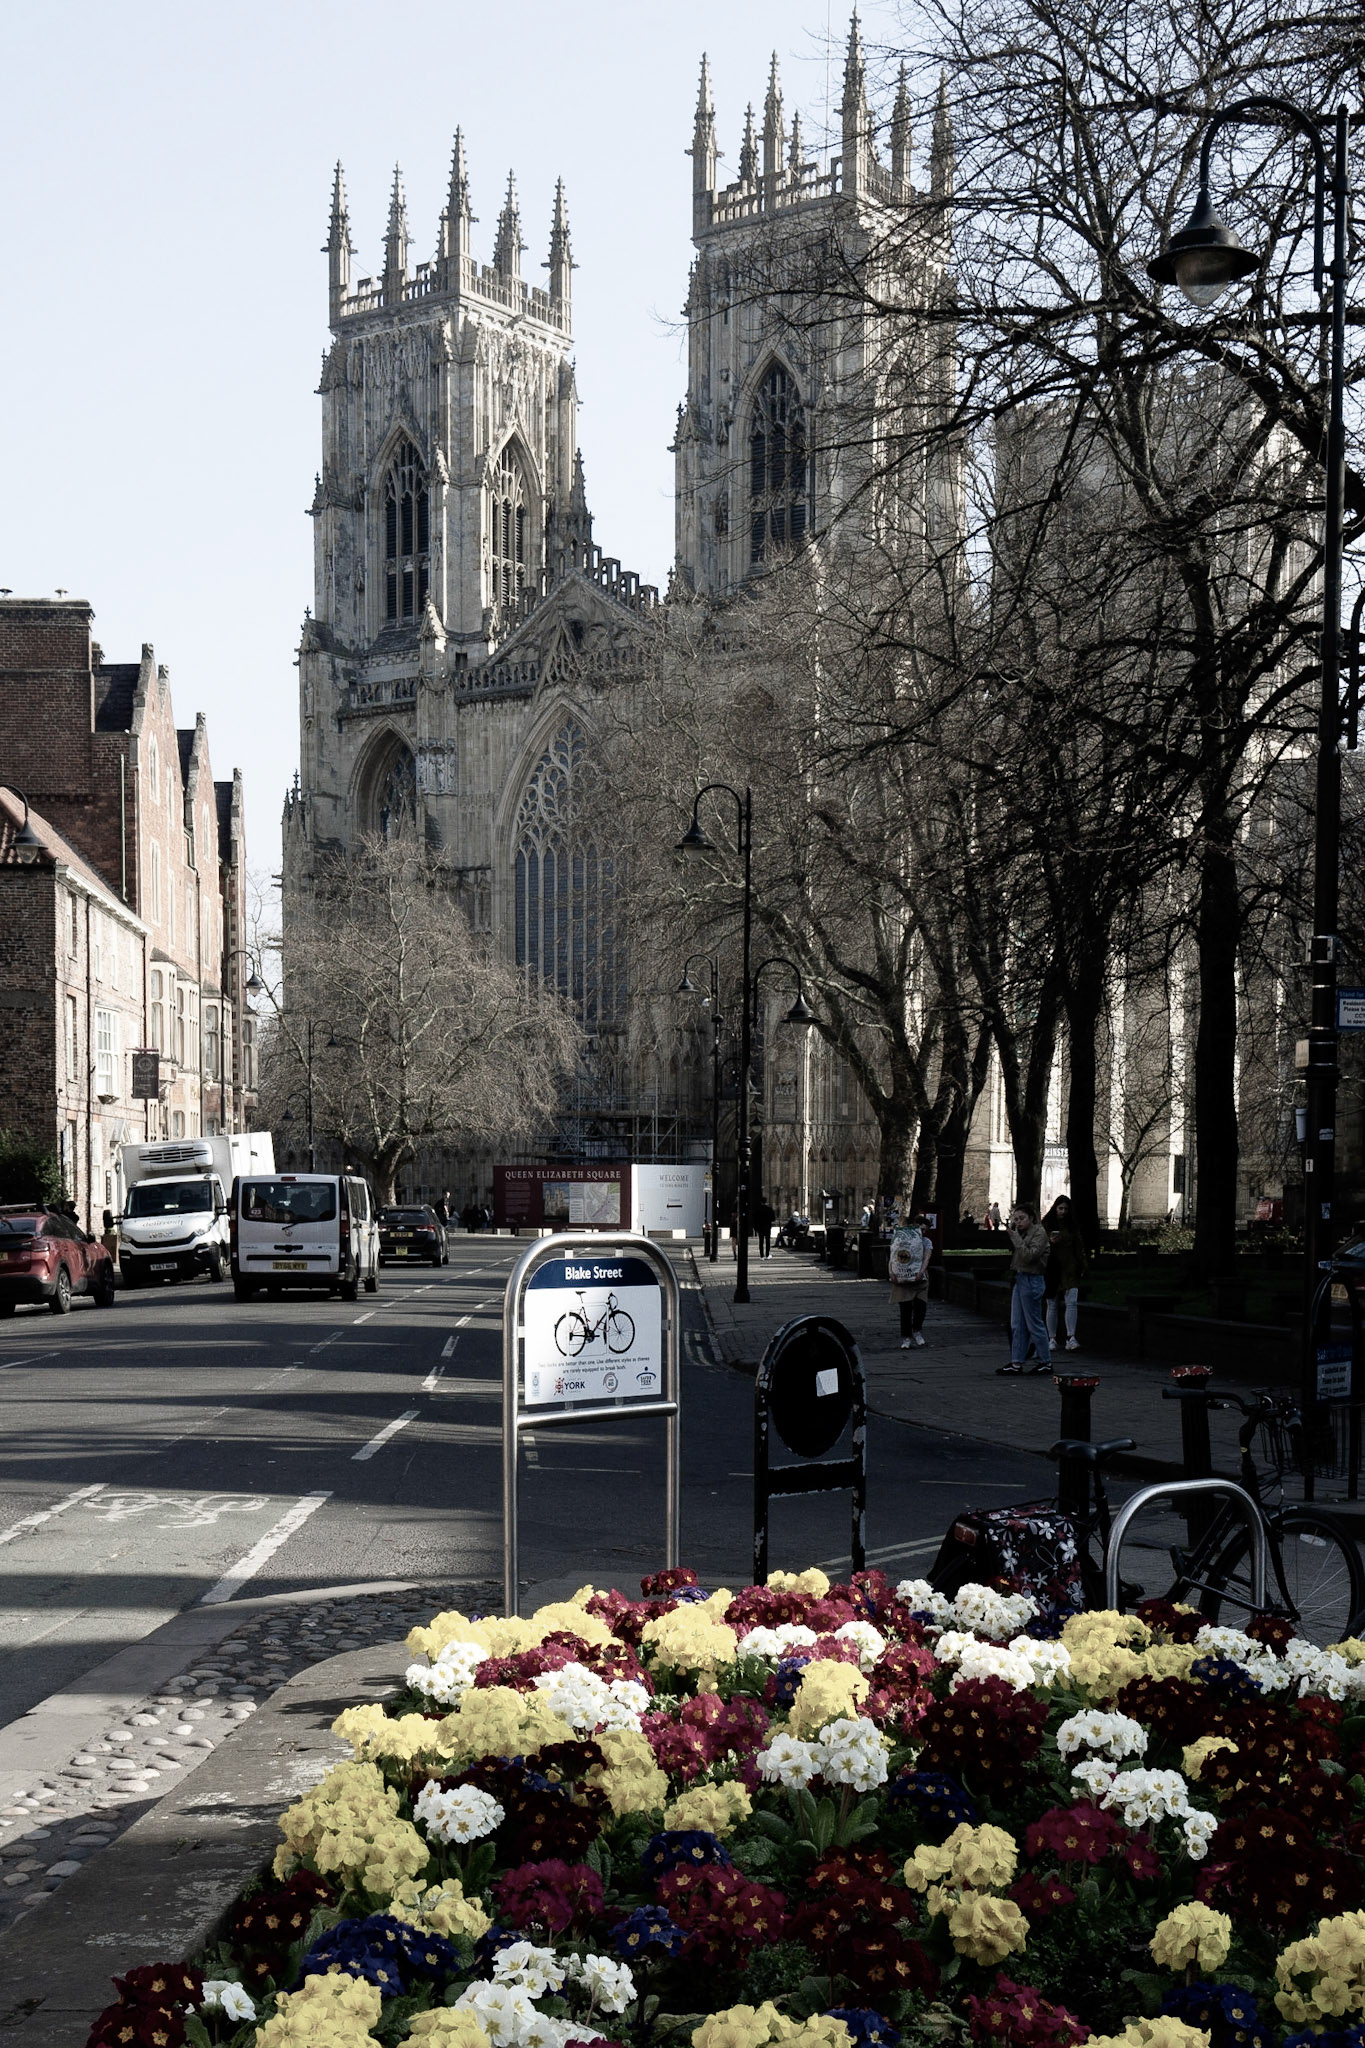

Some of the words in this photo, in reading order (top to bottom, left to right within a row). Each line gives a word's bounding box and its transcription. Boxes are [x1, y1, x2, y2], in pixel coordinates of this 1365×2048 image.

[505, 1170, 534, 1180] QUEEN
[537, 1170, 584, 1179] ELIZABETH
[587, 1170, 622, 1180] SQUARE
[660, 1174, 689, 1182] WELCOME
[565, 1266, 592, 1280] Blake
[593, 1265, 624, 1279] Street
[582, 1366, 600, 1374] equipped
[564, 1381, 586, 1390] YORK
